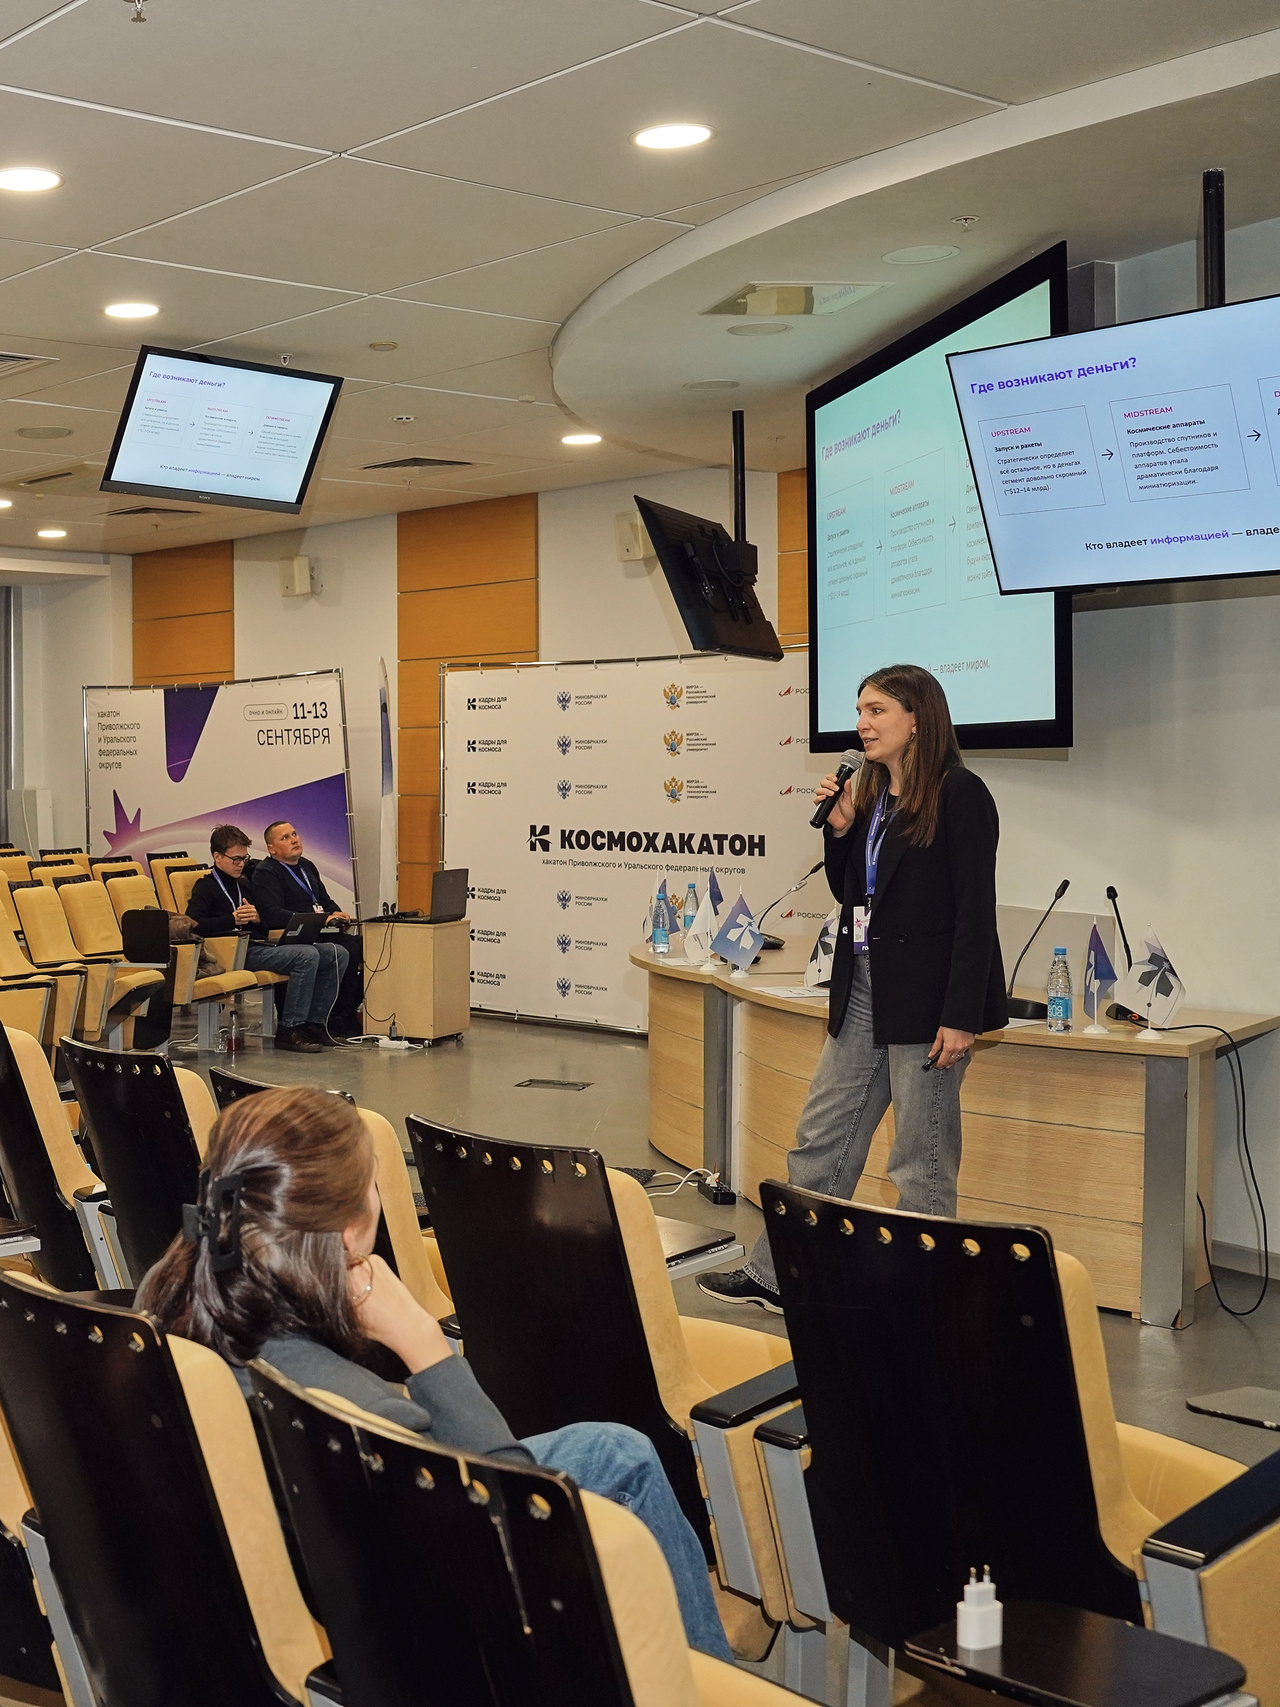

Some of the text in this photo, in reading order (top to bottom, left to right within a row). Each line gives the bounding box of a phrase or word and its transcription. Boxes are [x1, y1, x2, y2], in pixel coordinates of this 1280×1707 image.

[162, 374, 198, 384] возникают
[198, 379, 226, 388] деньги?
[970, 357, 1137, 394] Где возникают деньги?
[1123, 406, 1173, 419] MIDSTREAM
[991, 426, 1032, 438] UPSTREAM
[1126, 419, 1206, 435] Космические аппараты
[821, 409, 901, 461] Где возникают деньги?
[1129, 437, 1176, 449] Производство
[1176, 432, 1212, 442] спутников
[994, 445, 1014, 453] Запуск
[1020, 441, 1043, 450] ракеты
[1167, 443, 1219, 454] Себестоимость
[997, 450, 1075, 465] Стратегически определяет
[1057, 460, 1081, 468] деньгах
[1134, 458, 1189, 469] аппаратов упала
[1002, 469, 1087, 485] сегмент довольно скромный
[1136, 465, 1219, 481] драматически благодаря
[1085, 541, 1104, 551] Кто
[1105, 538, 1148, 549] владеет
[1150, 530, 1230, 547] информацией
[939, 661, 965, 675] владеет
[97, 710, 120, 718] хакатон
[292, 701, 328, 719] 11-13
[97, 722, 141, 732] Приволжского
[102, 735, 137, 745] Уральского
[257, 728, 331, 746] СЕНТЯБРЯ
[98, 748, 138, 758] федеральных
[99, 761, 122, 770] округов
[560, 829, 766, 857] КОСМОХАКАТОН
[568, 859, 616, 869] Приволжского
[624, 861, 664, 871] Уральского
[715, 867, 746, 875] округов
